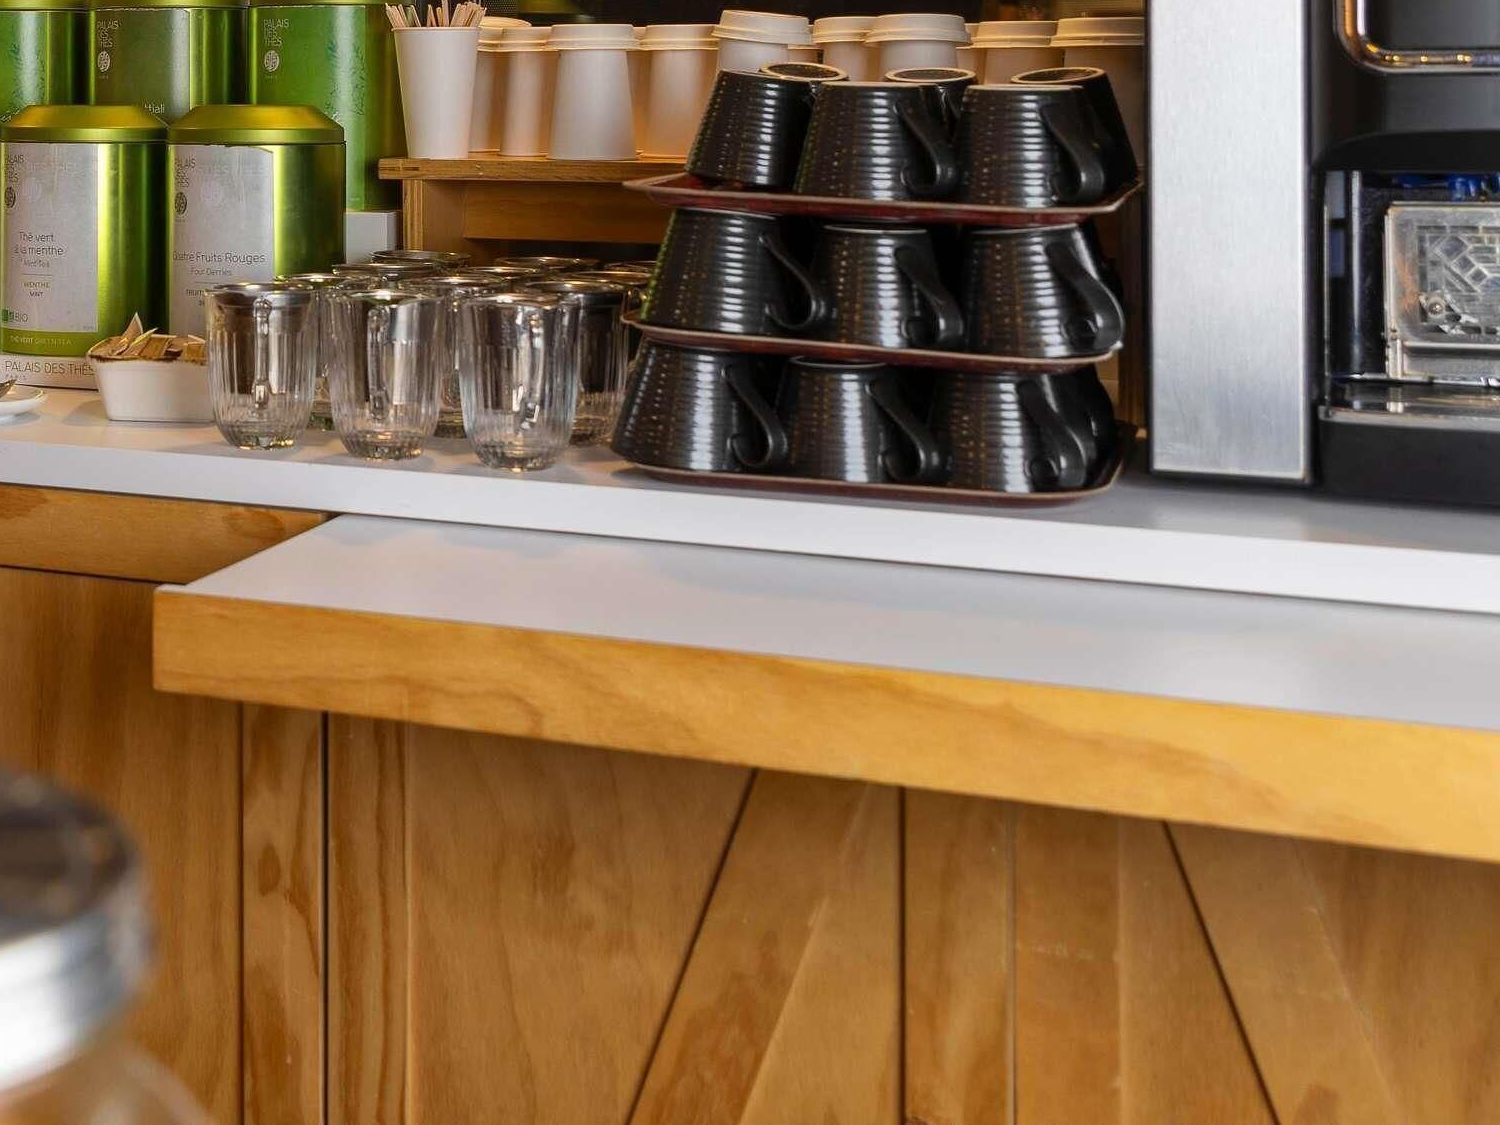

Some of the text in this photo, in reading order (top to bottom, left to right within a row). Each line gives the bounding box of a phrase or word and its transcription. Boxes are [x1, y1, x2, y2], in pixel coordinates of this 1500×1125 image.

[35, 232, 54, 243] vert
[28, 245, 64, 255] menthe
[196, 252, 223, 263] Fruits
[225, 253, 266, 265] Rouges
[13, 312, 29, 323] BIO
[4, 361, 94, 376] PALAIS DES THÉS
